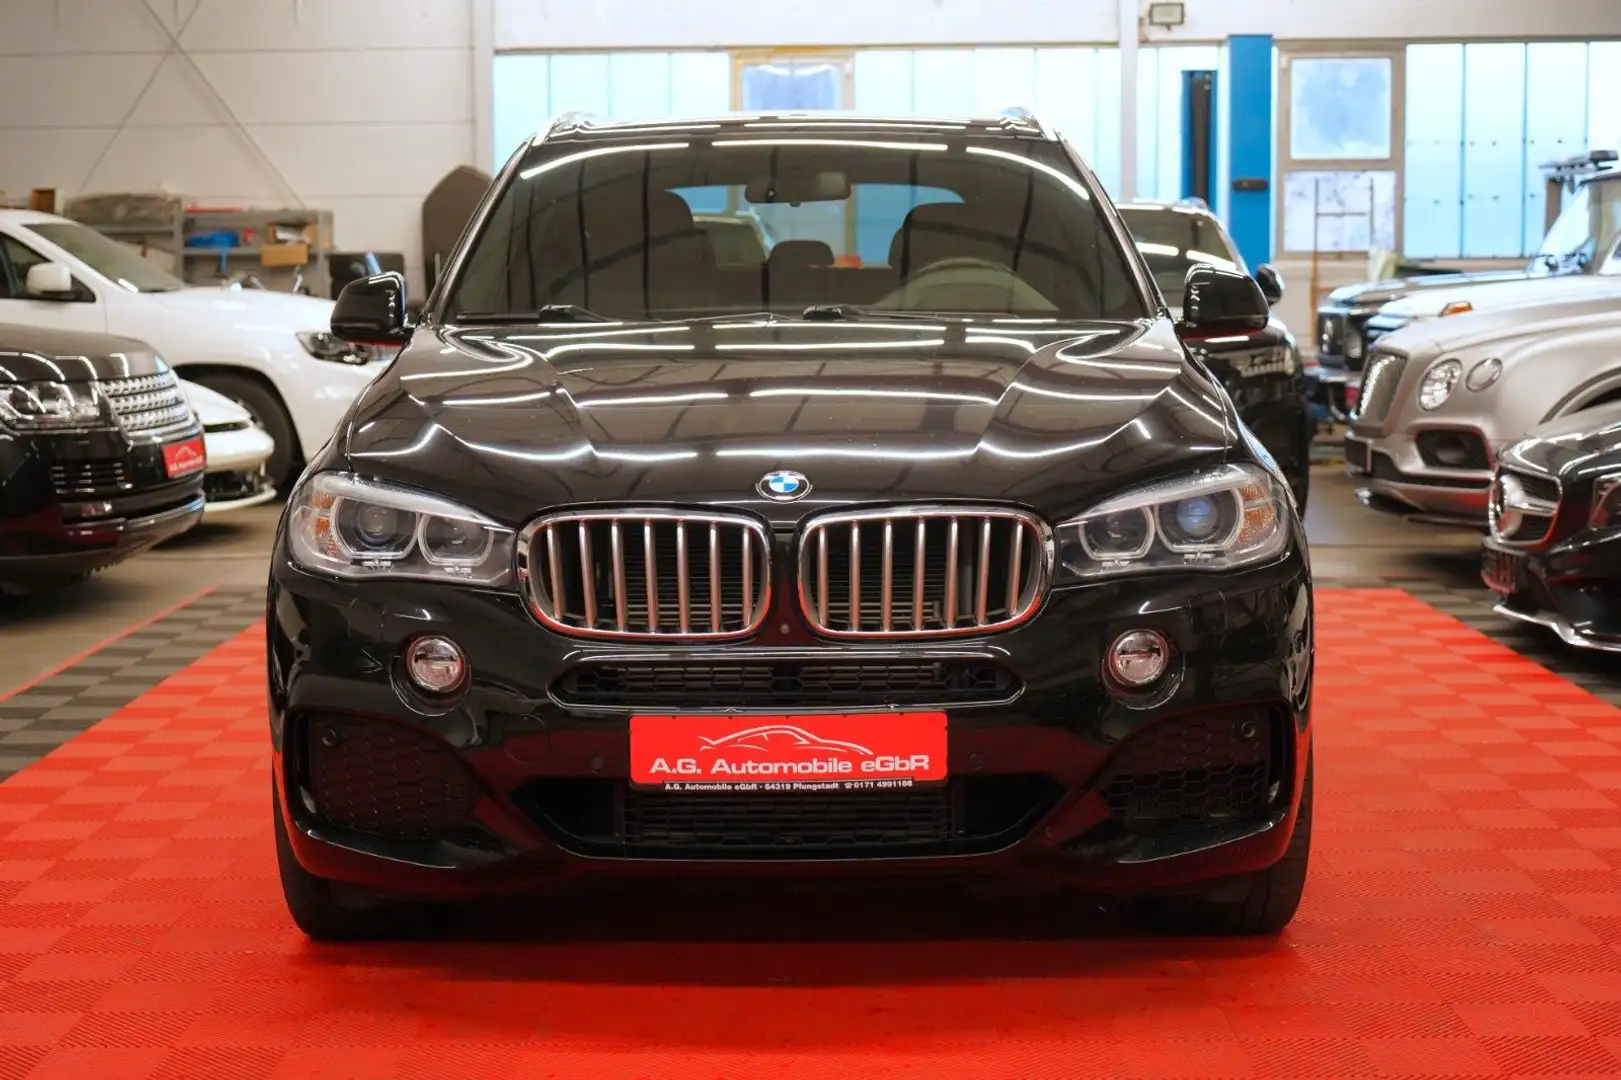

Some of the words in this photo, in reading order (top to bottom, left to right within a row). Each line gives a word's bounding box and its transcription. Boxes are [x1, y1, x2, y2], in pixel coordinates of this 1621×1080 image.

[650, 758, 702, 774] A.G.
[711, 757, 853, 774] Automobile
[860, 754, 930, 772] eGbR
[793, 782, 839, 791] Pfungstadt
[854, 781, 874, 789] 0171
